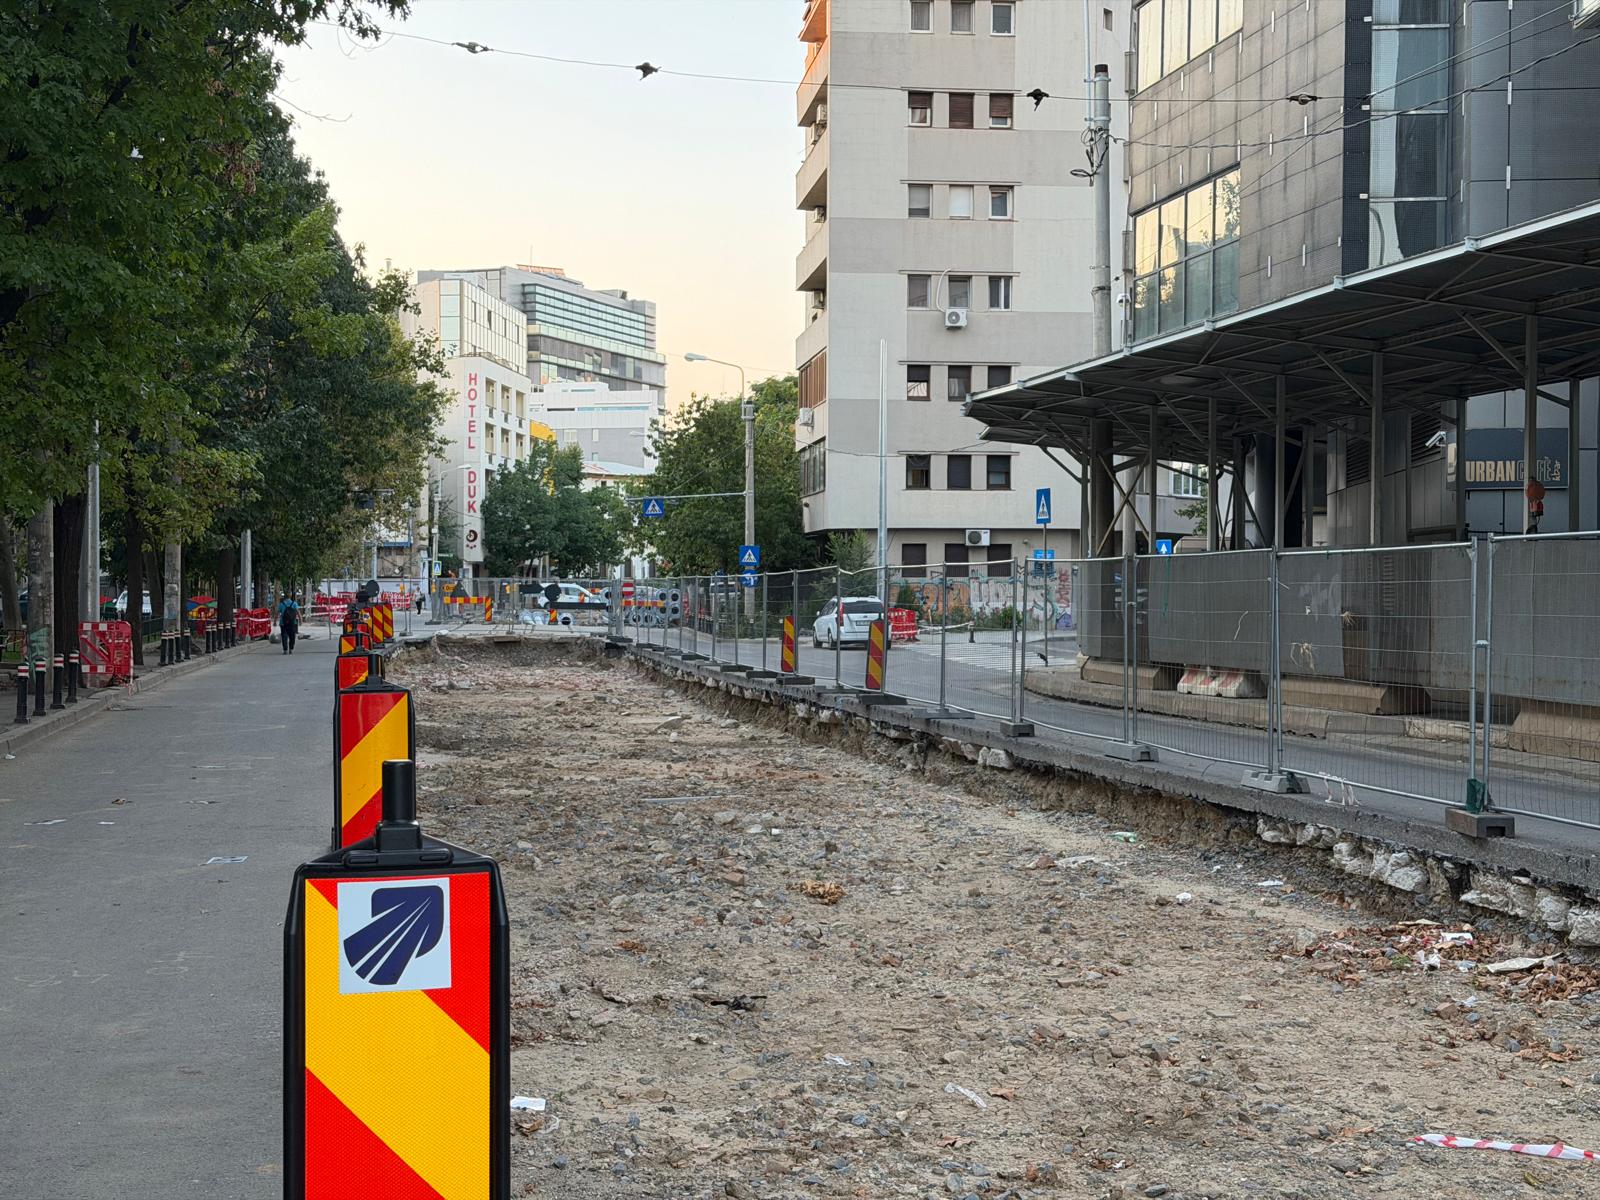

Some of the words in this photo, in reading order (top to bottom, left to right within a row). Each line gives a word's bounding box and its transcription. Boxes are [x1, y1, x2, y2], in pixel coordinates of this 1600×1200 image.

[468, 373, 478, 449] HOTEL
[467, 471, 477, 513] DUK
[1465, 460, 1515, 482] URBAN
